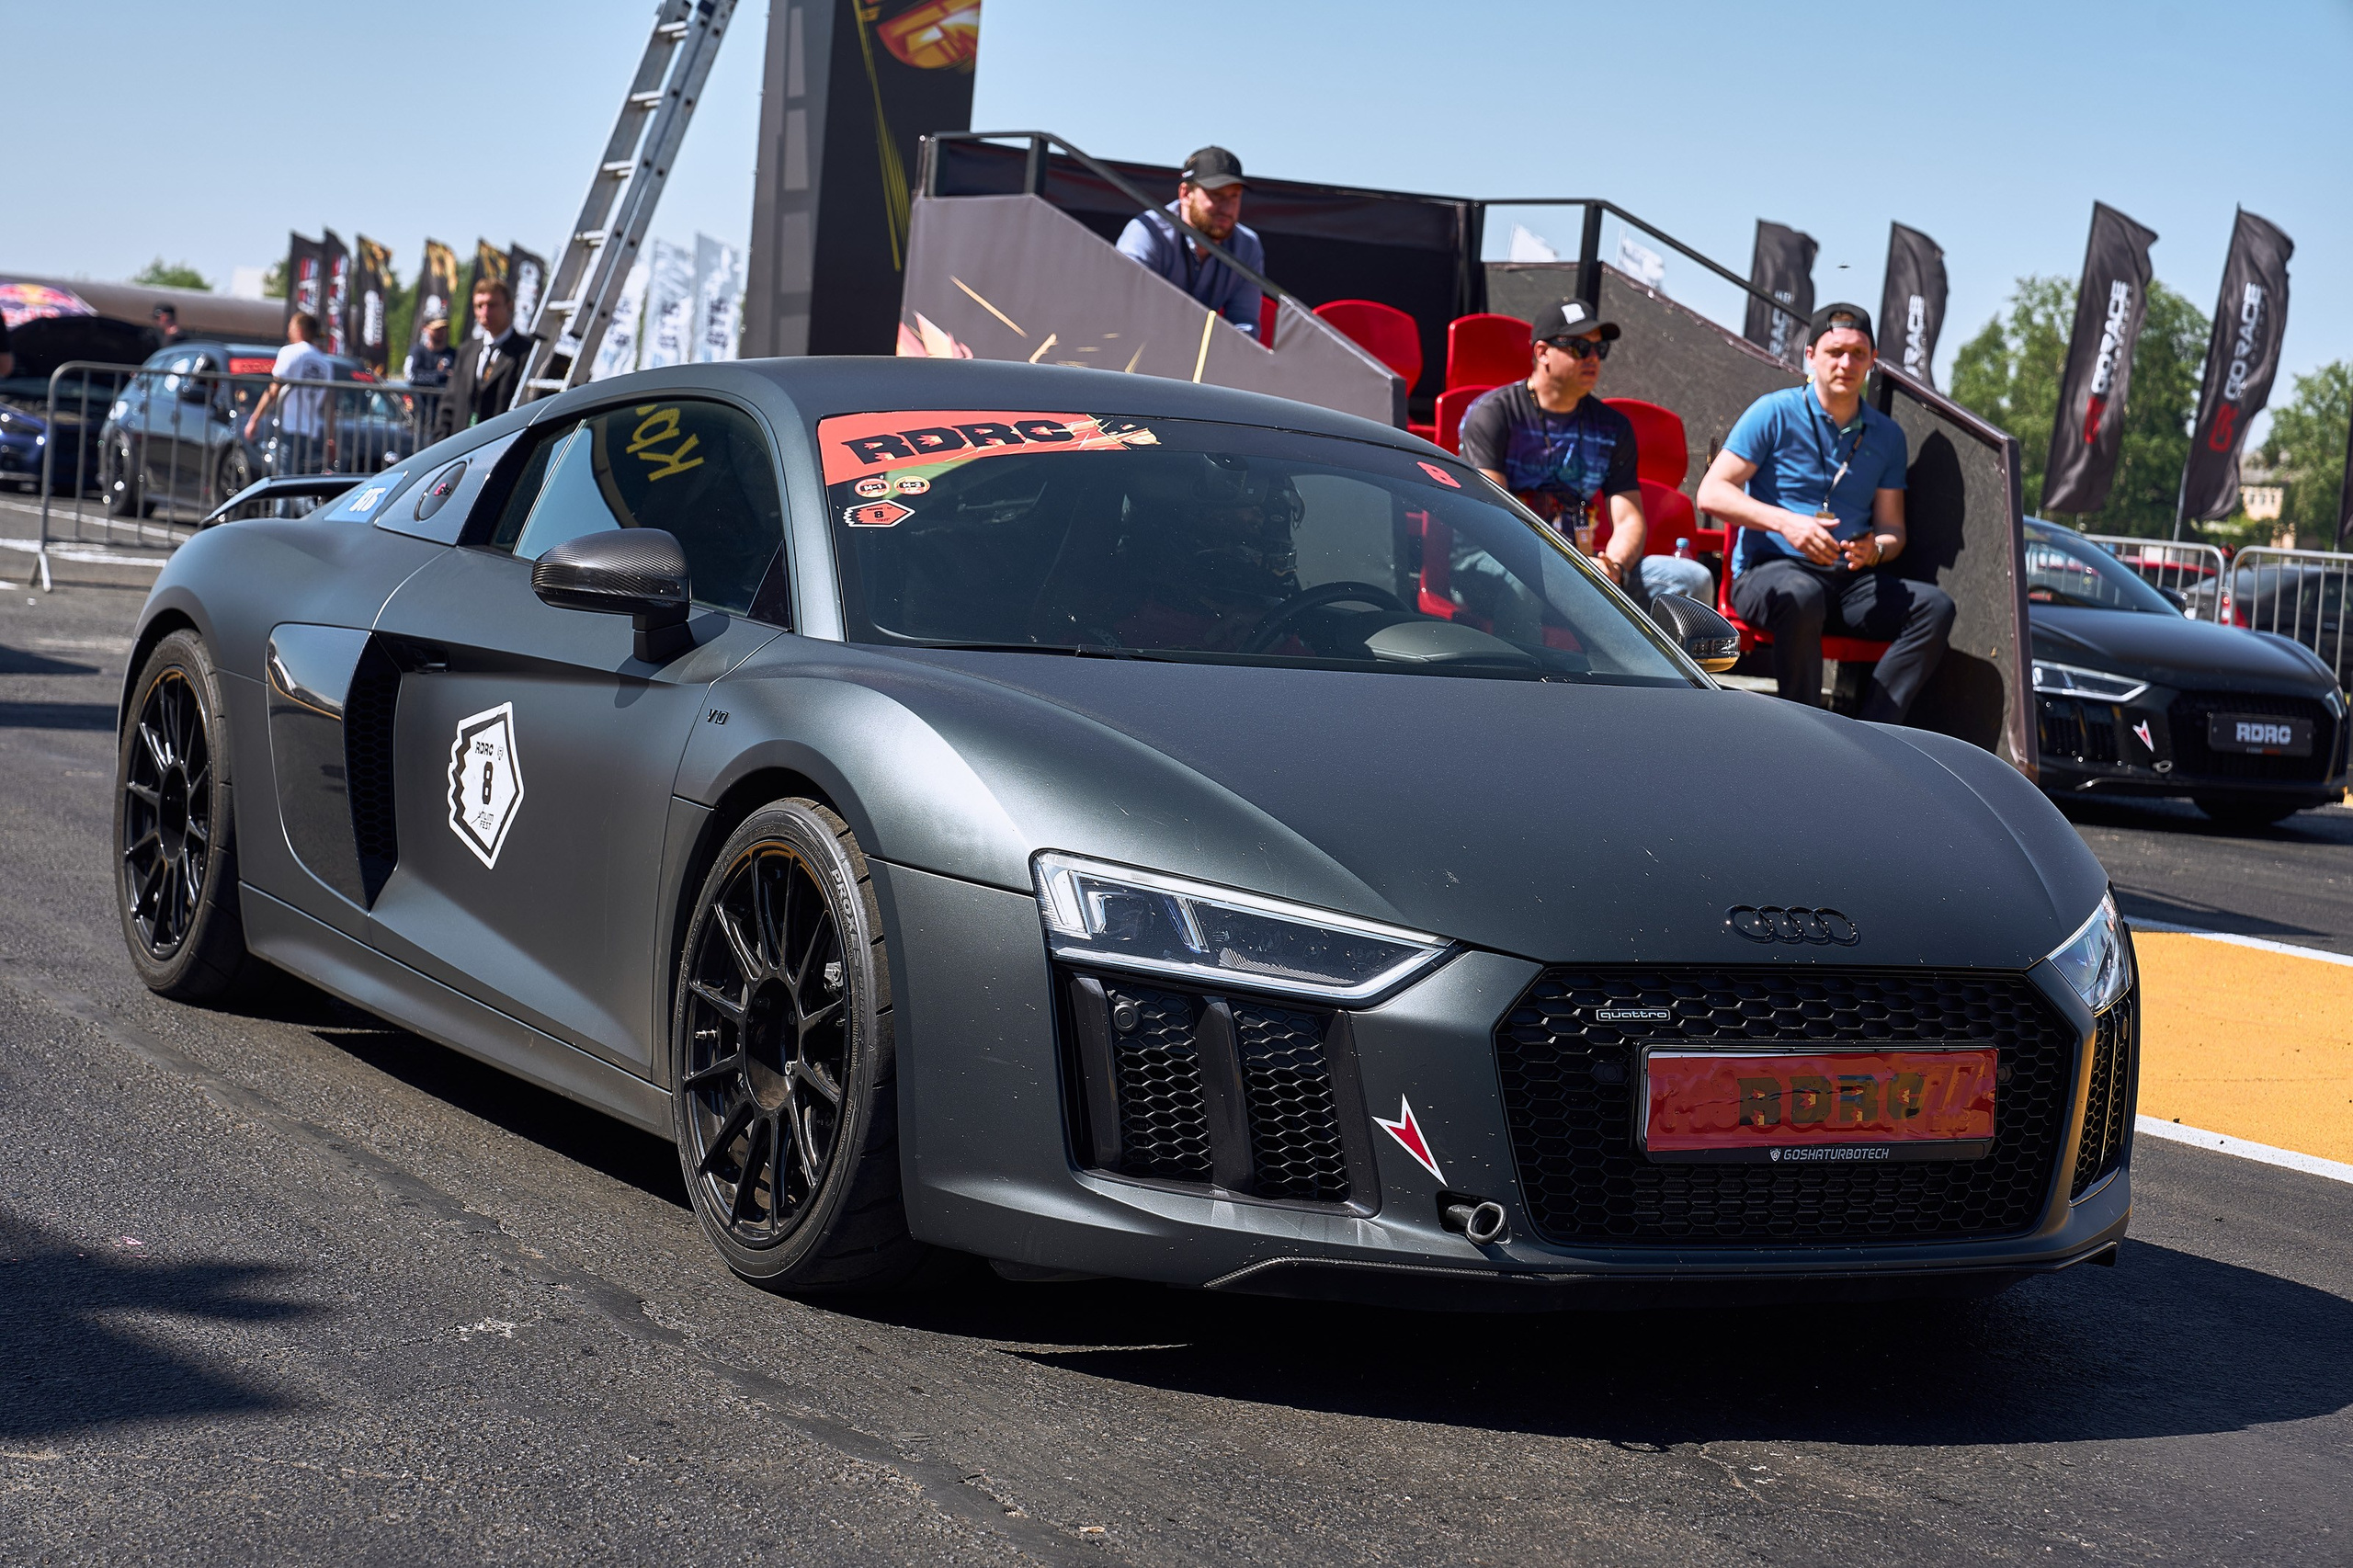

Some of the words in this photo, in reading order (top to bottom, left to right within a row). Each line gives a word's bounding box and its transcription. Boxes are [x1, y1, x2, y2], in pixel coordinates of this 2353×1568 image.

[841, 420, 1075, 465] RDRC
[707, 709, 730, 725] V10
[2235, 722, 2291, 745] RDRC
[474, 741, 494, 756] RDRC
[482, 761, 494, 805] 8
[831, 868, 863, 969] PROXES
[1600, 1010, 1668, 1019] quattro
[1783, 1148, 1890, 1160] GOSHATURBOTECH
